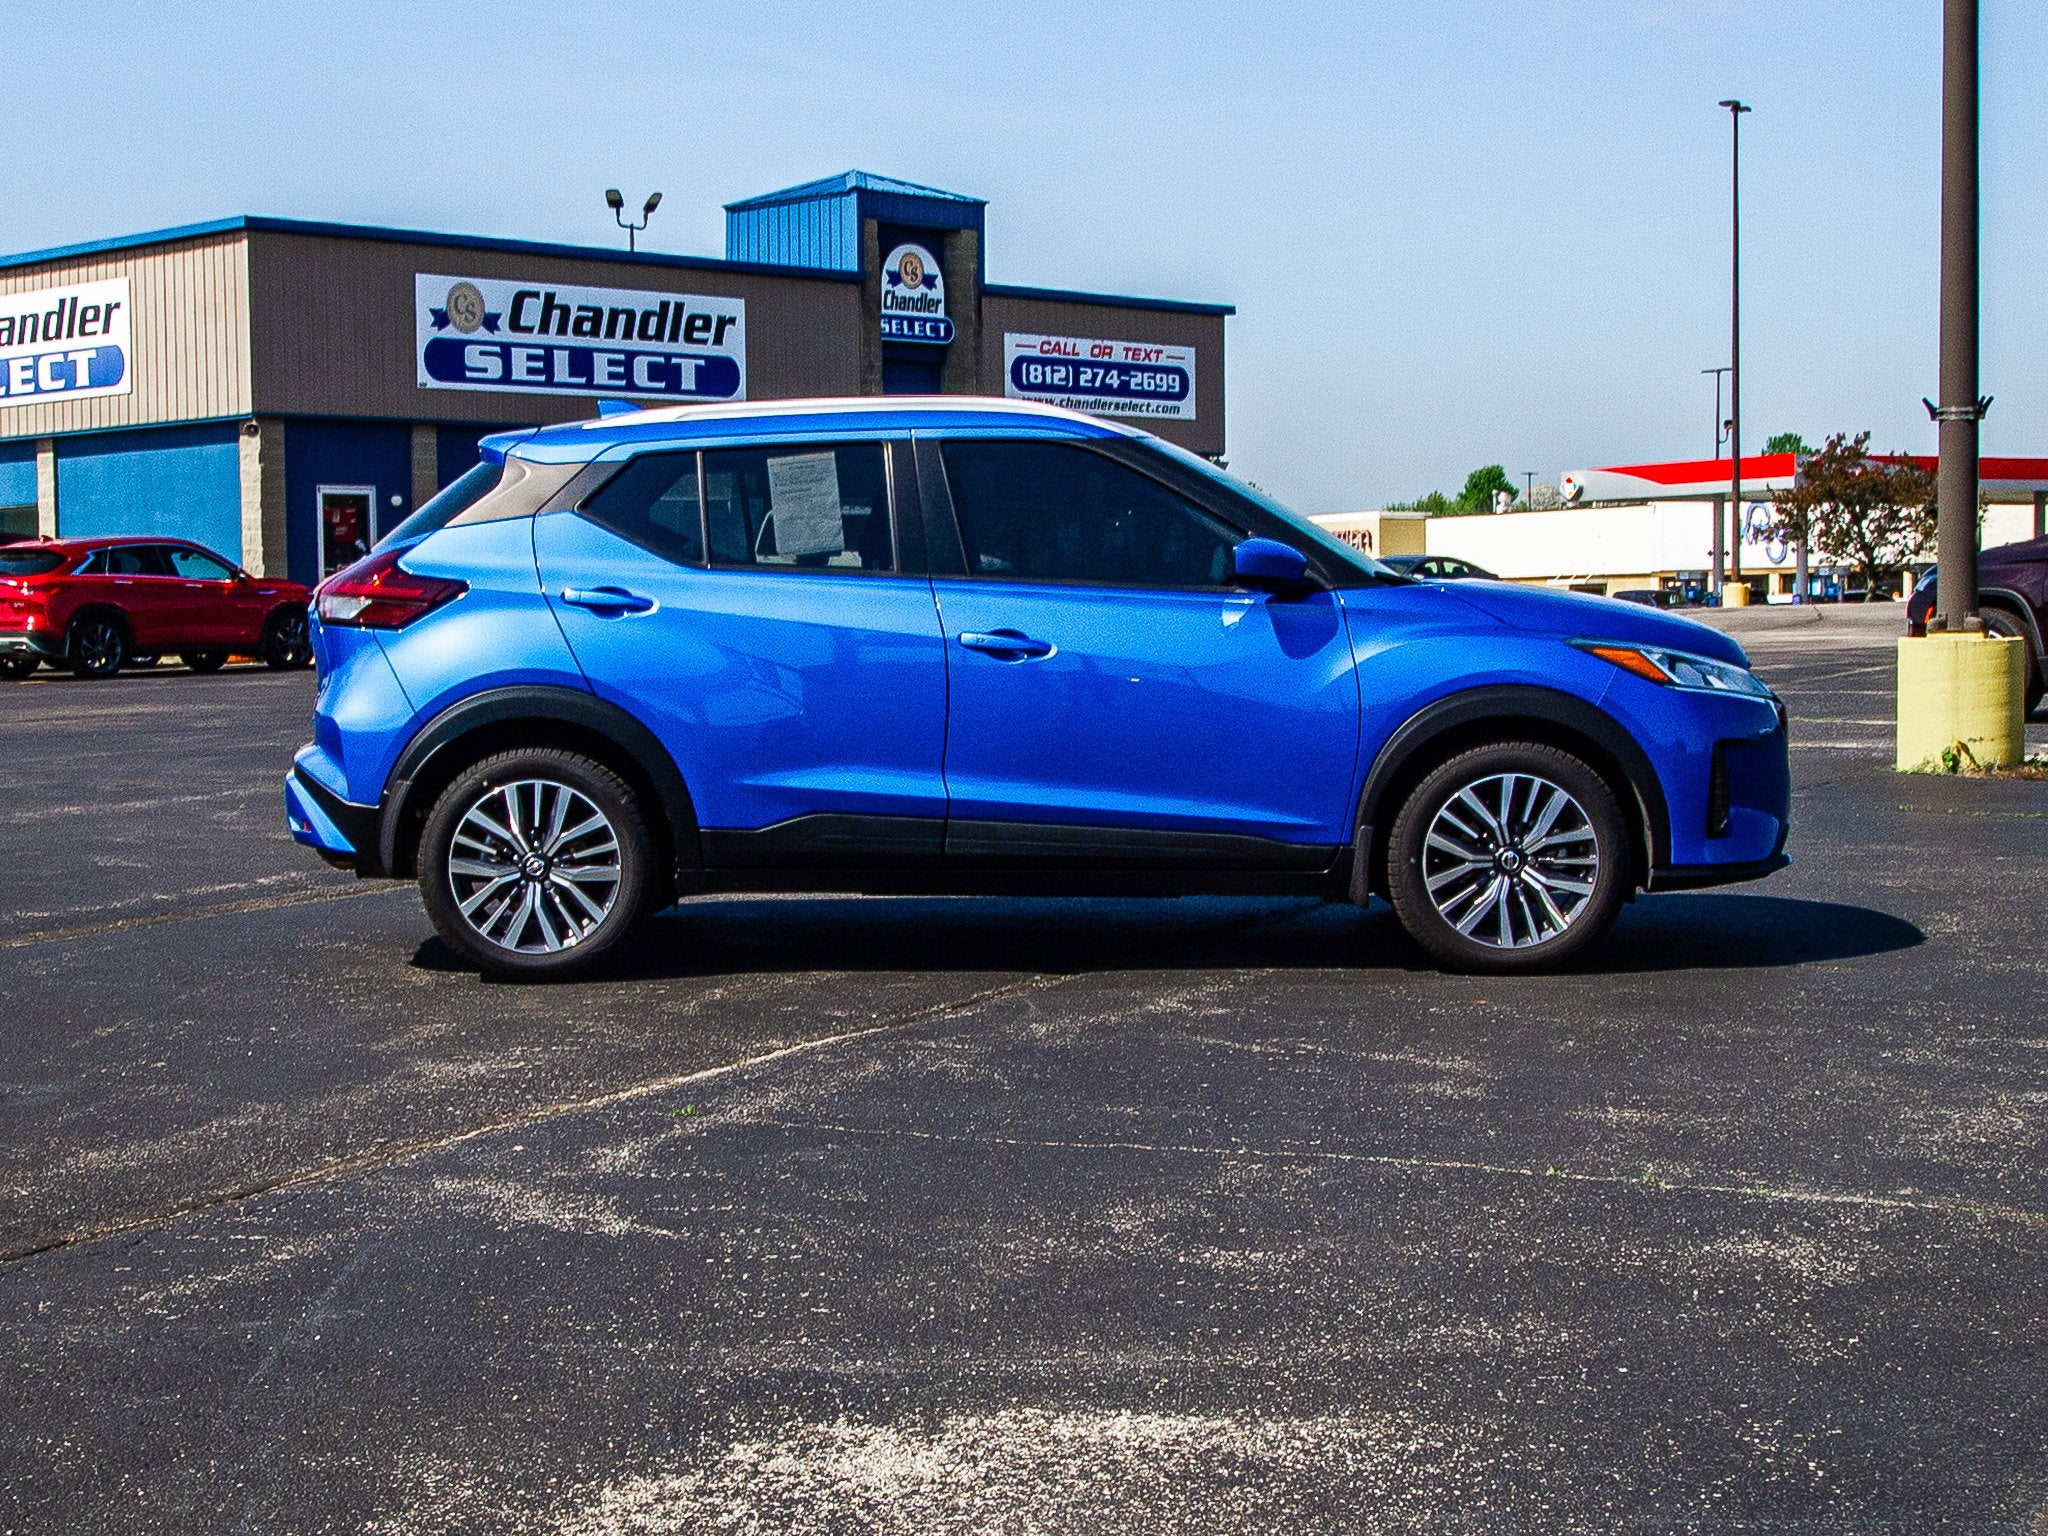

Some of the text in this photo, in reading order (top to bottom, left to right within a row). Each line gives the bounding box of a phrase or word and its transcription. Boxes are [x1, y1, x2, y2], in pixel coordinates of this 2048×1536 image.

[883, 289, 942, 314] Chandler
[508, 289, 737, 346] Chandler
[881, 318, 947, 337] SELECT
[1039, 340, 1164, 363] CALL OR TEXT
[0, 349, 97, 396] ECT
[464, 344, 705, 391] SELECT
[1021, 362, 1180, 393] (812) 274-2699
